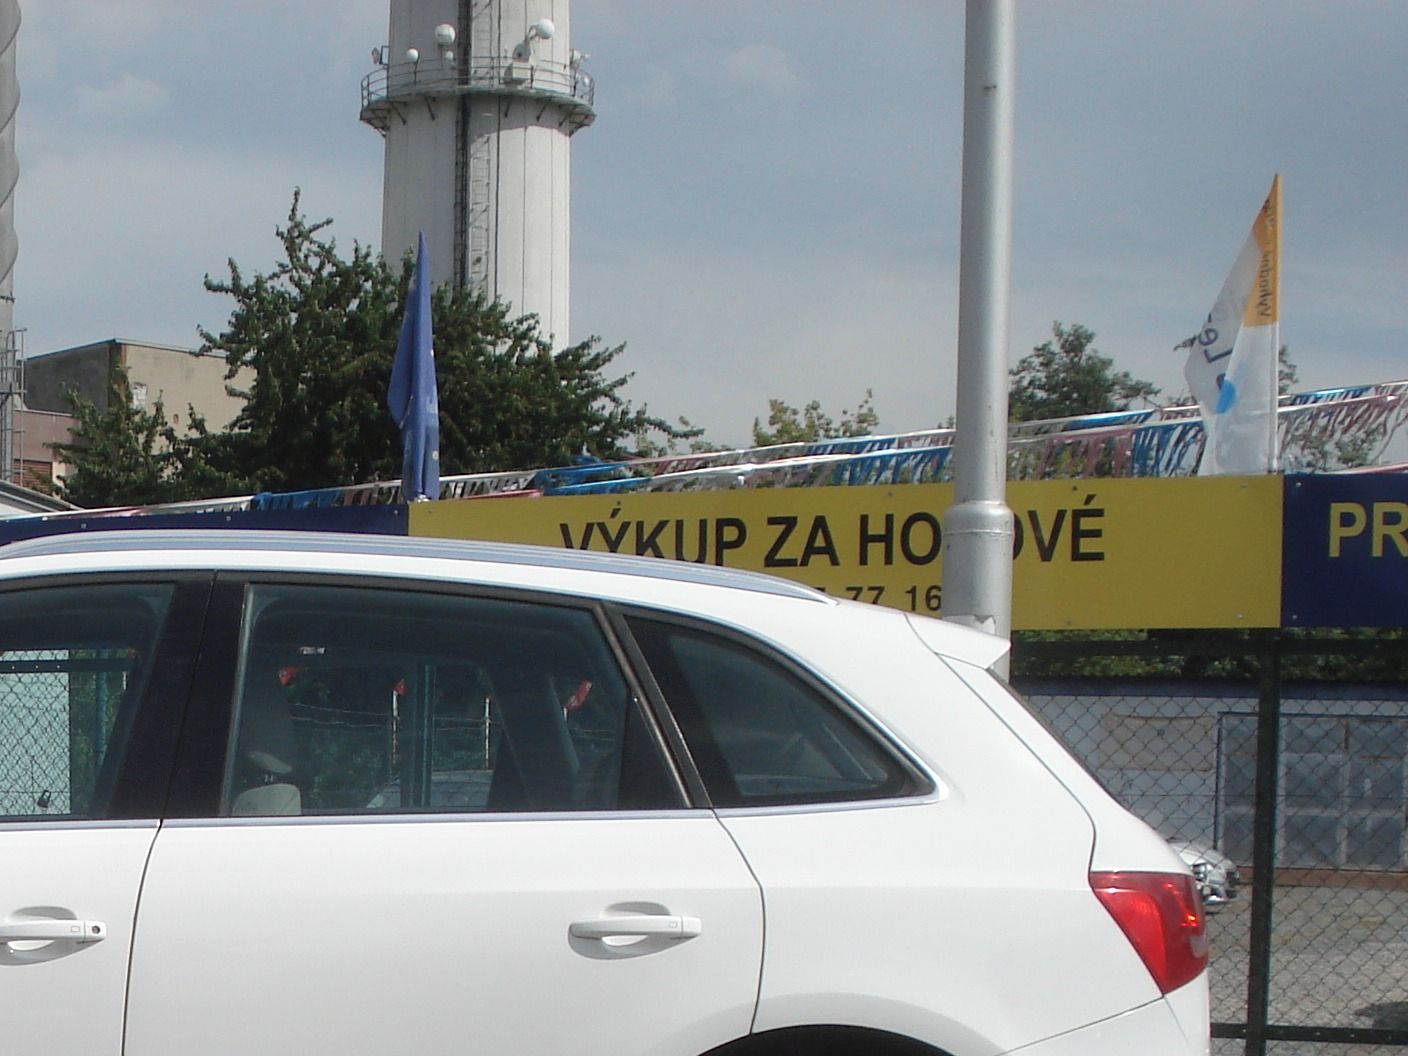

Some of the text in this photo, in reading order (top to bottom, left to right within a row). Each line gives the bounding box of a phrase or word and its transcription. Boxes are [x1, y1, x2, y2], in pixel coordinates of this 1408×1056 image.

[560, 494, 1105, 567] VÝKUP ZA HOVÉ
[905, 585, 942, 612] 16
